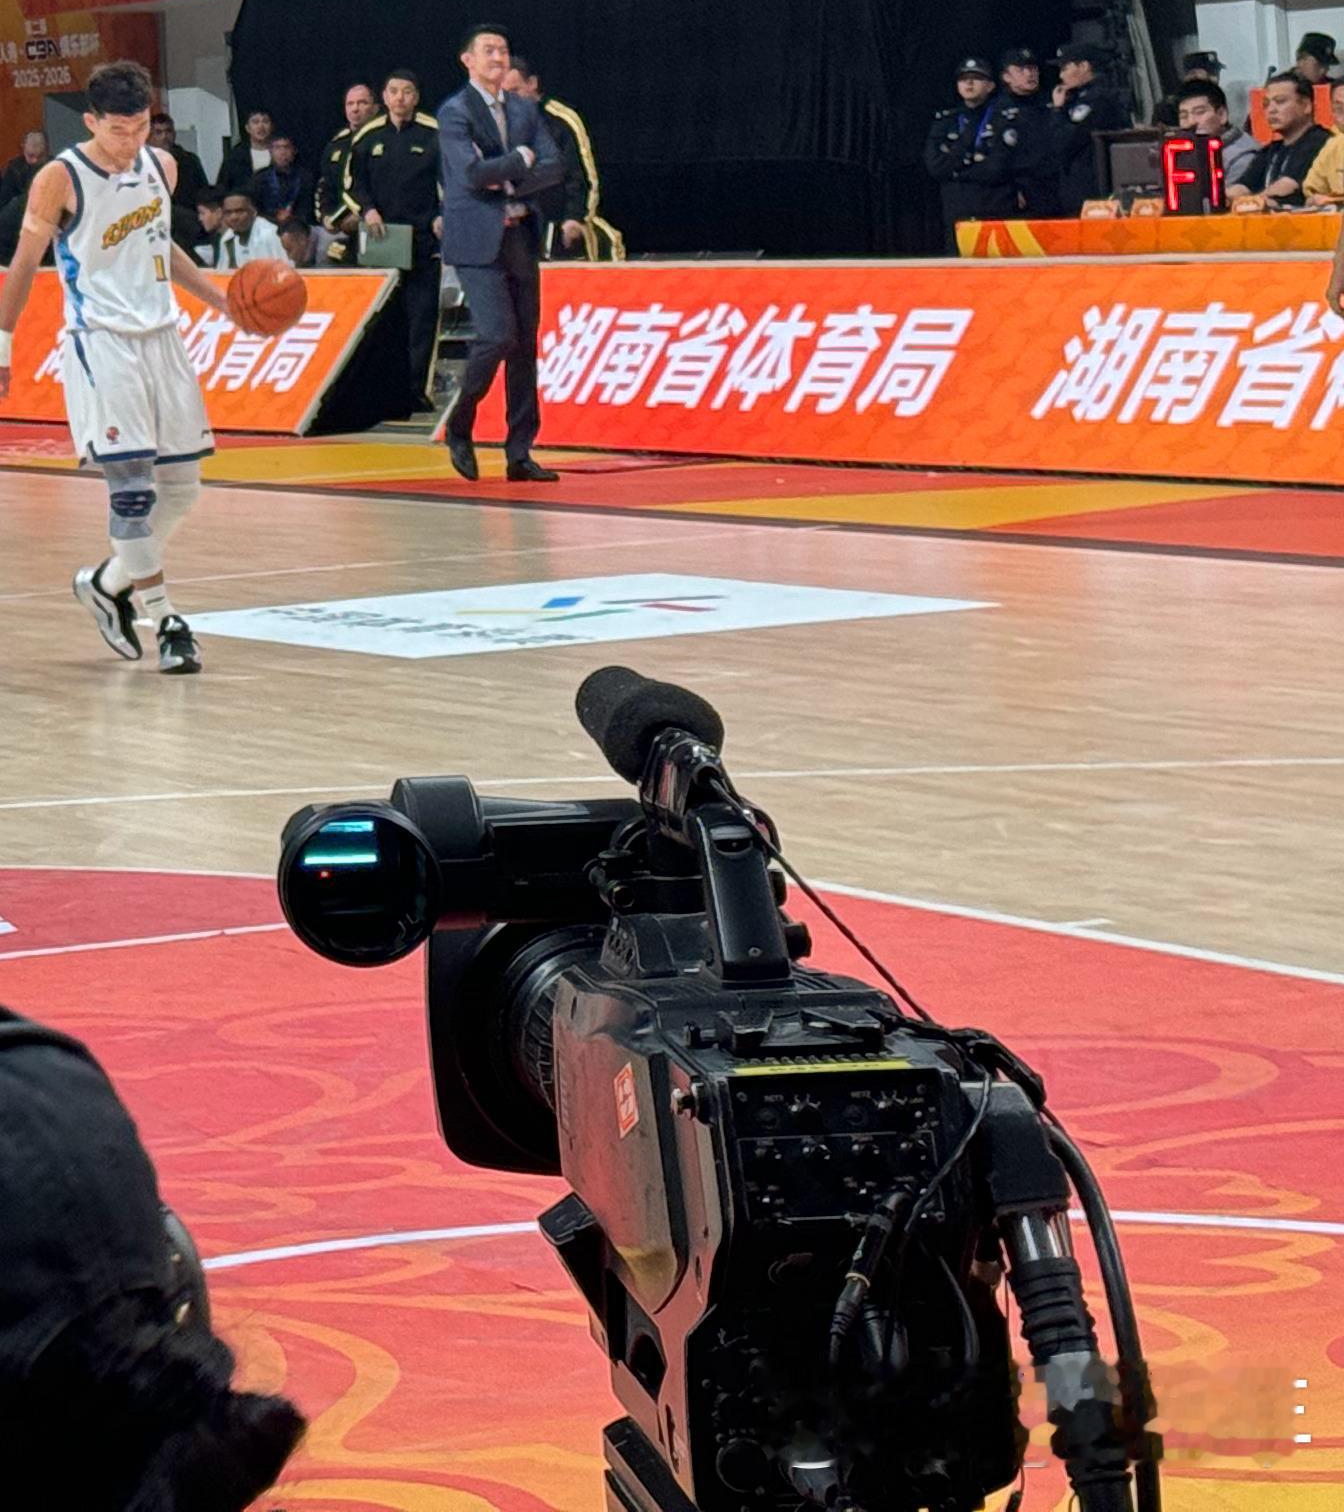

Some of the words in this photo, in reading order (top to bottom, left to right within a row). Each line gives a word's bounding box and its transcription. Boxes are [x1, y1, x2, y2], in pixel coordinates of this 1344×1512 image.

[537, 302, 973, 418] 湖南省体育局
